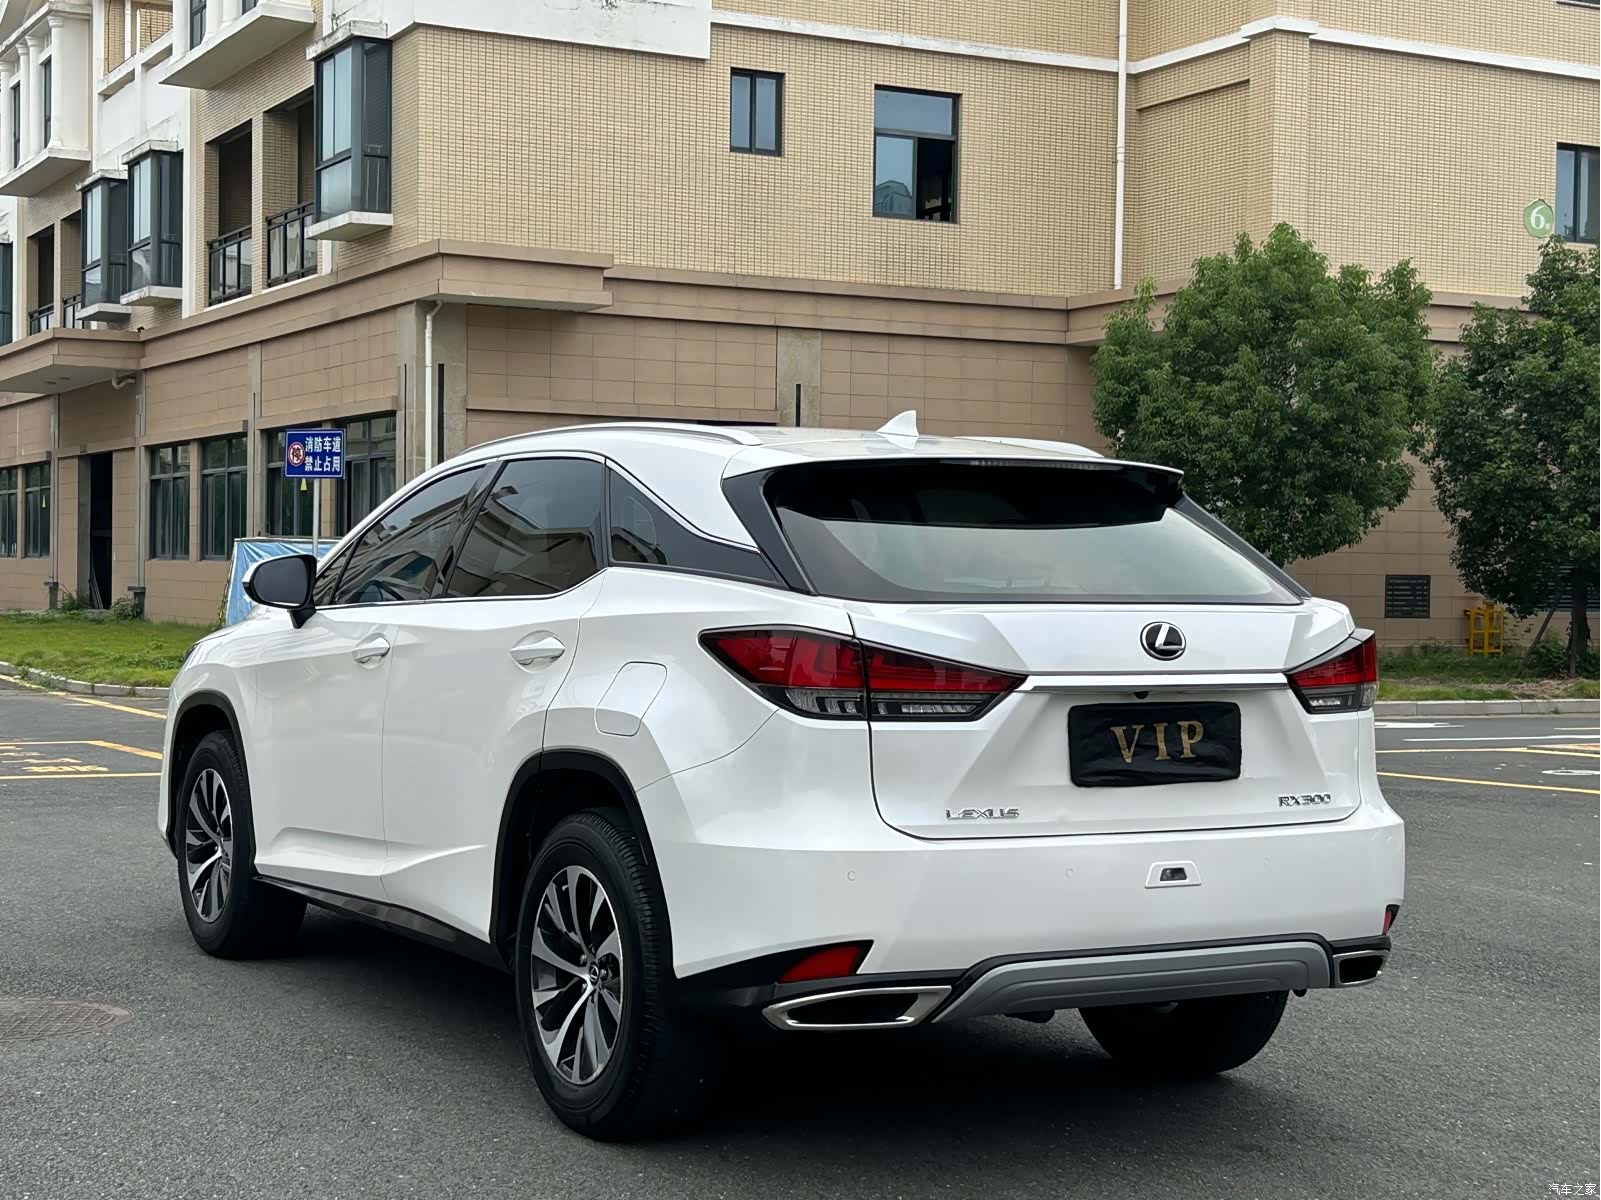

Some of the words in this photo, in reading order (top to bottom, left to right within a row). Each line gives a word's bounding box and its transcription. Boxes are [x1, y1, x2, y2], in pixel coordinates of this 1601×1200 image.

[305, 436, 341, 453] 消防车道
[304, 455, 341, 472] 禁止占用
[1109, 720, 1204, 763] VIP
[945, 807, 1020, 821] LEXUS
